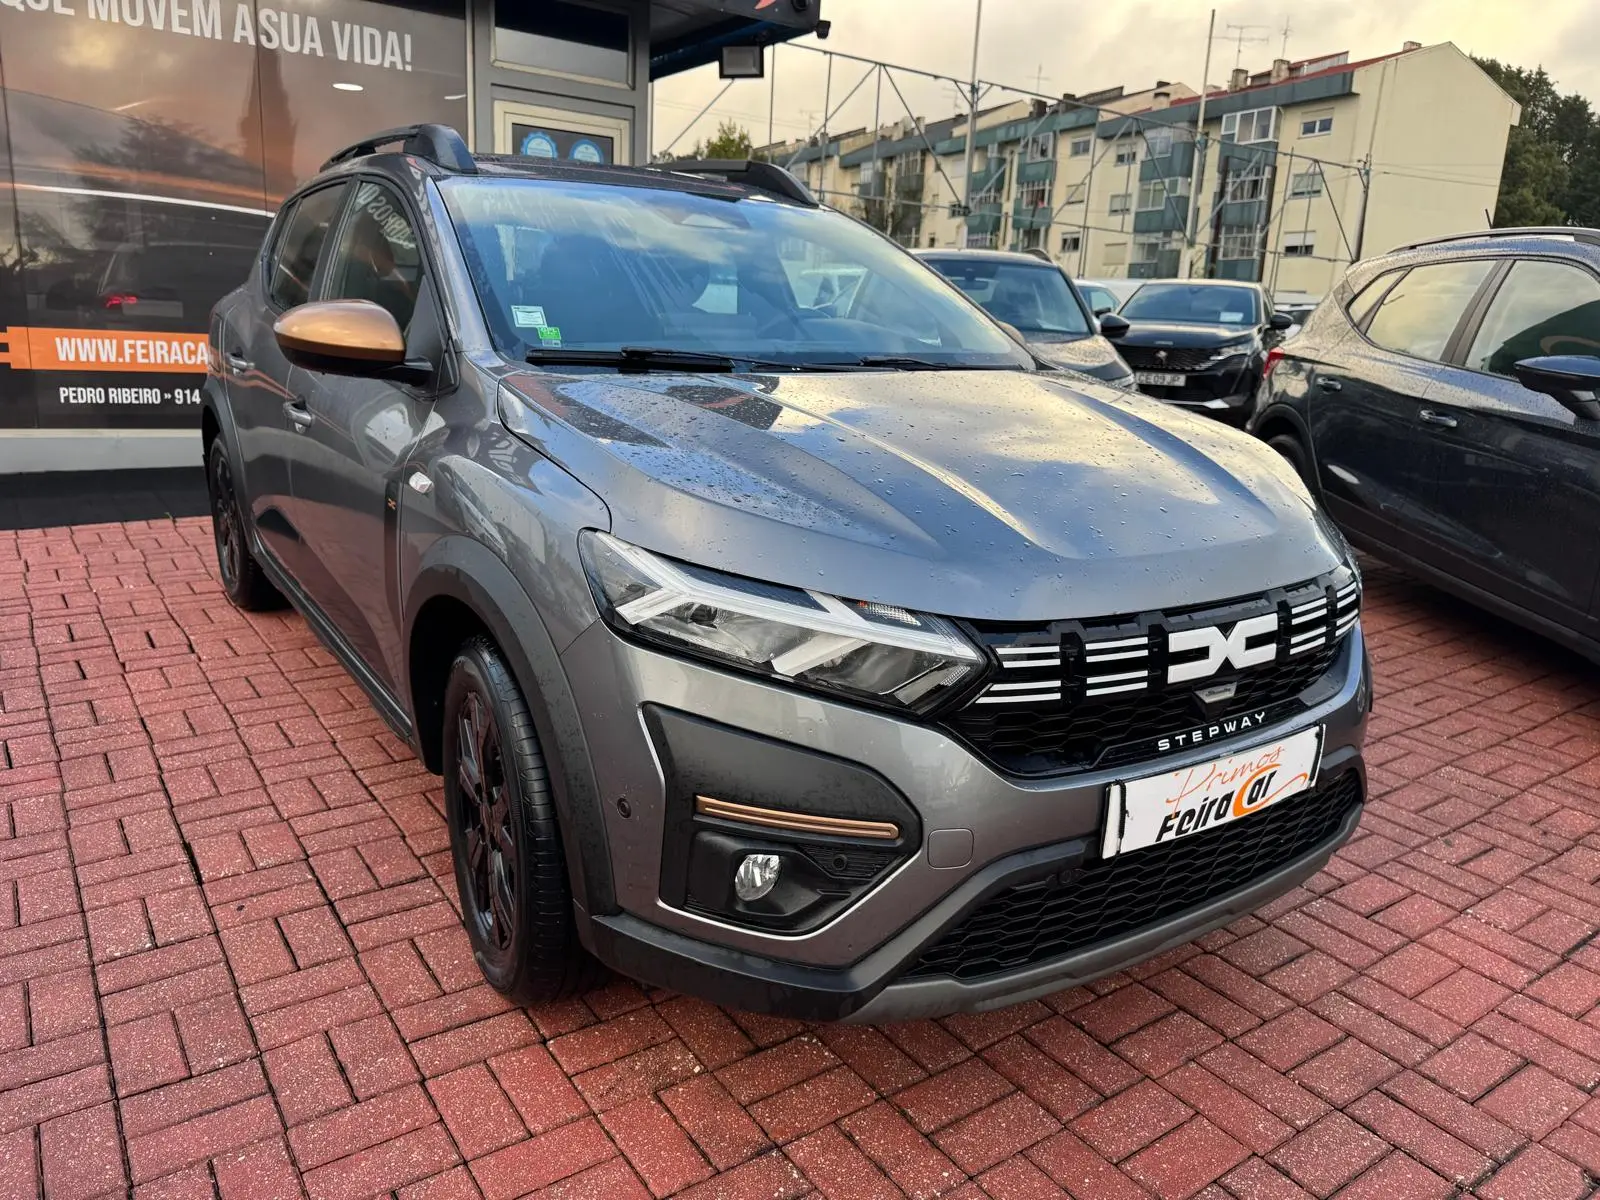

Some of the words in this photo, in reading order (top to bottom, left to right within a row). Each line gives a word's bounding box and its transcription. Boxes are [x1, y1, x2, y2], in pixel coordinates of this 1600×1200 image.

[331, 20, 412, 71] VIDA!
[55, 336, 209, 365] WWW.FEIRACA
[59, 387, 105, 404] PEDRO
[108, 387, 161, 405] RIBEIRO
[174, 388, 202, 405] 914
[1157, 711, 1266, 751] STEPWAY
